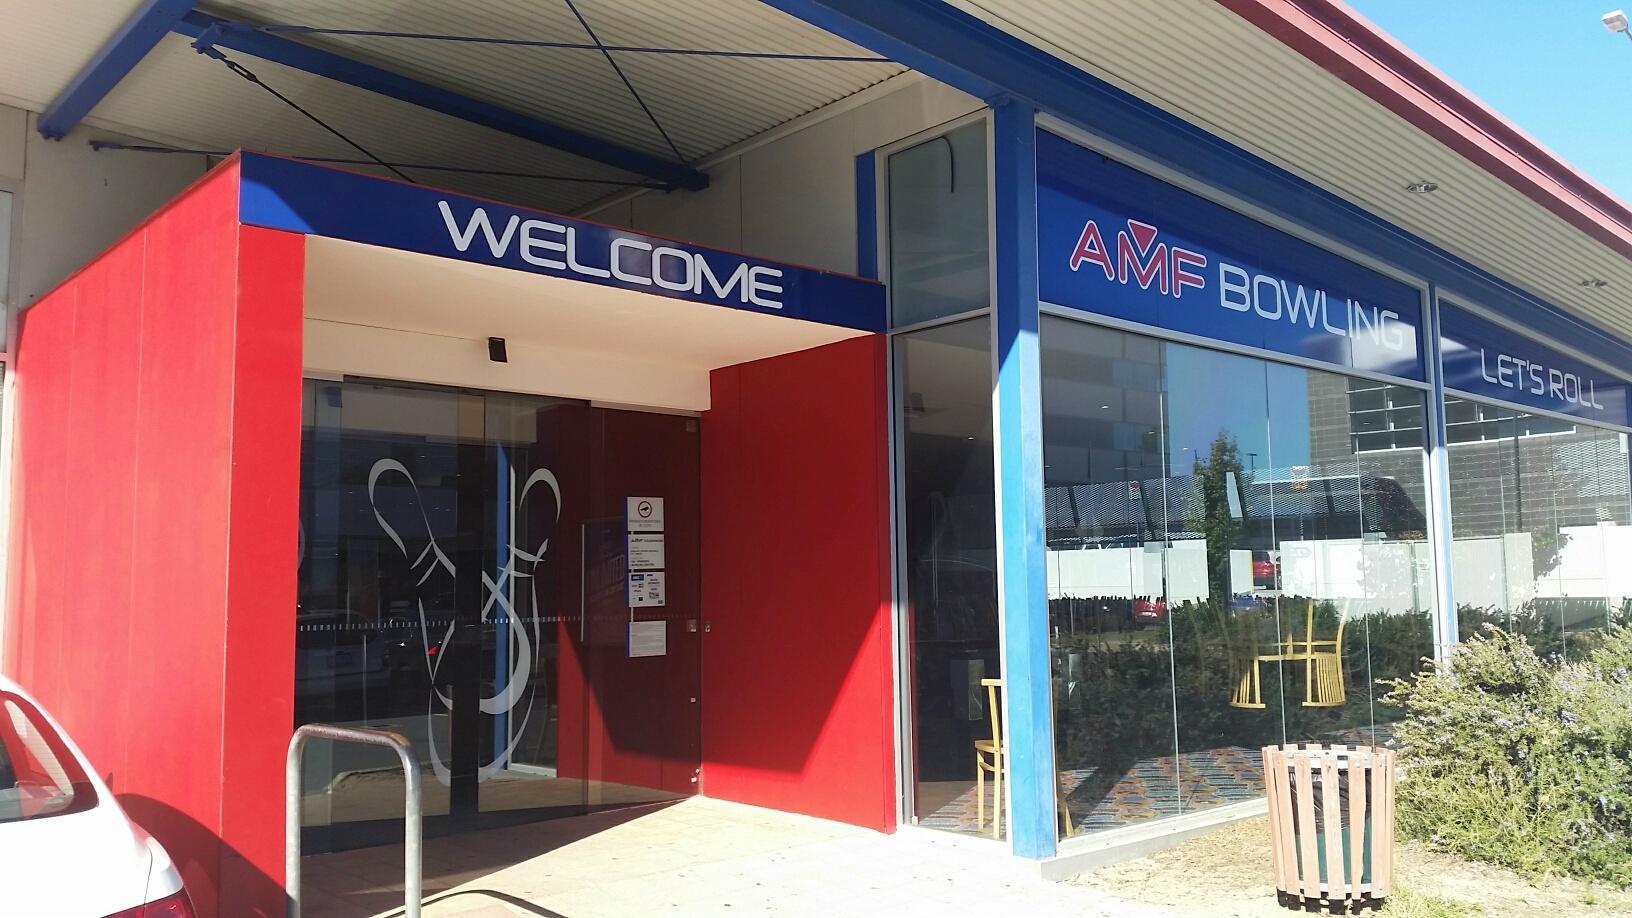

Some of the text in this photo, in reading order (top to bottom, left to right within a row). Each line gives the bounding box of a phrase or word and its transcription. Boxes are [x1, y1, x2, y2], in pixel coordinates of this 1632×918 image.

[438, 200, 783, 309] WELCOME
[1069, 219, 1403, 350] AMF BOWLING
[1480, 348, 1604, 410] LET'S ROLL
